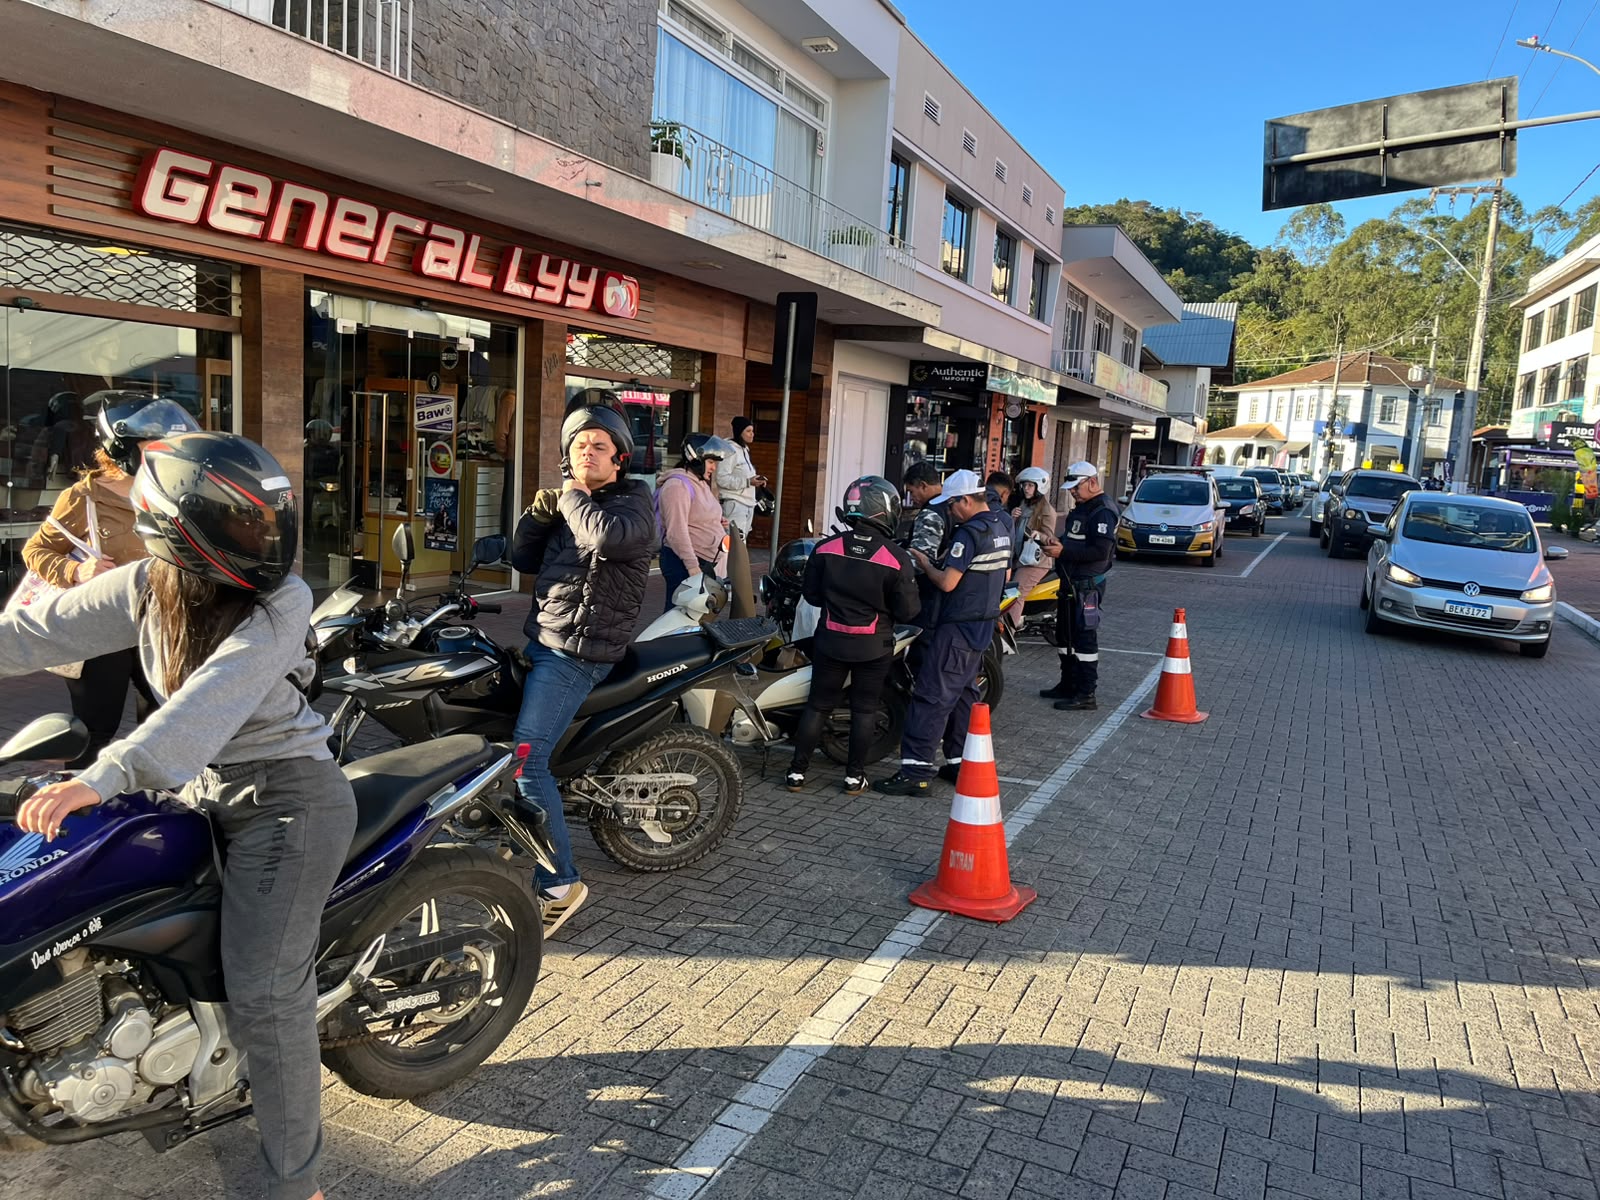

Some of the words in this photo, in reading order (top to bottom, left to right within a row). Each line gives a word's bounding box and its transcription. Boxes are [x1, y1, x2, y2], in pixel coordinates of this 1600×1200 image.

[931, 366, 985, 377] Authentic
[417, 408, 444, 421] Baw
[1565, 426, 1595, 436] TUDO
[1448, 605, 1488, 618] BEK3172
[646, 663, 689, 683] HONDA
[374, 699, 413, 711] 190
[0, 848, 69, 886] HONDA
